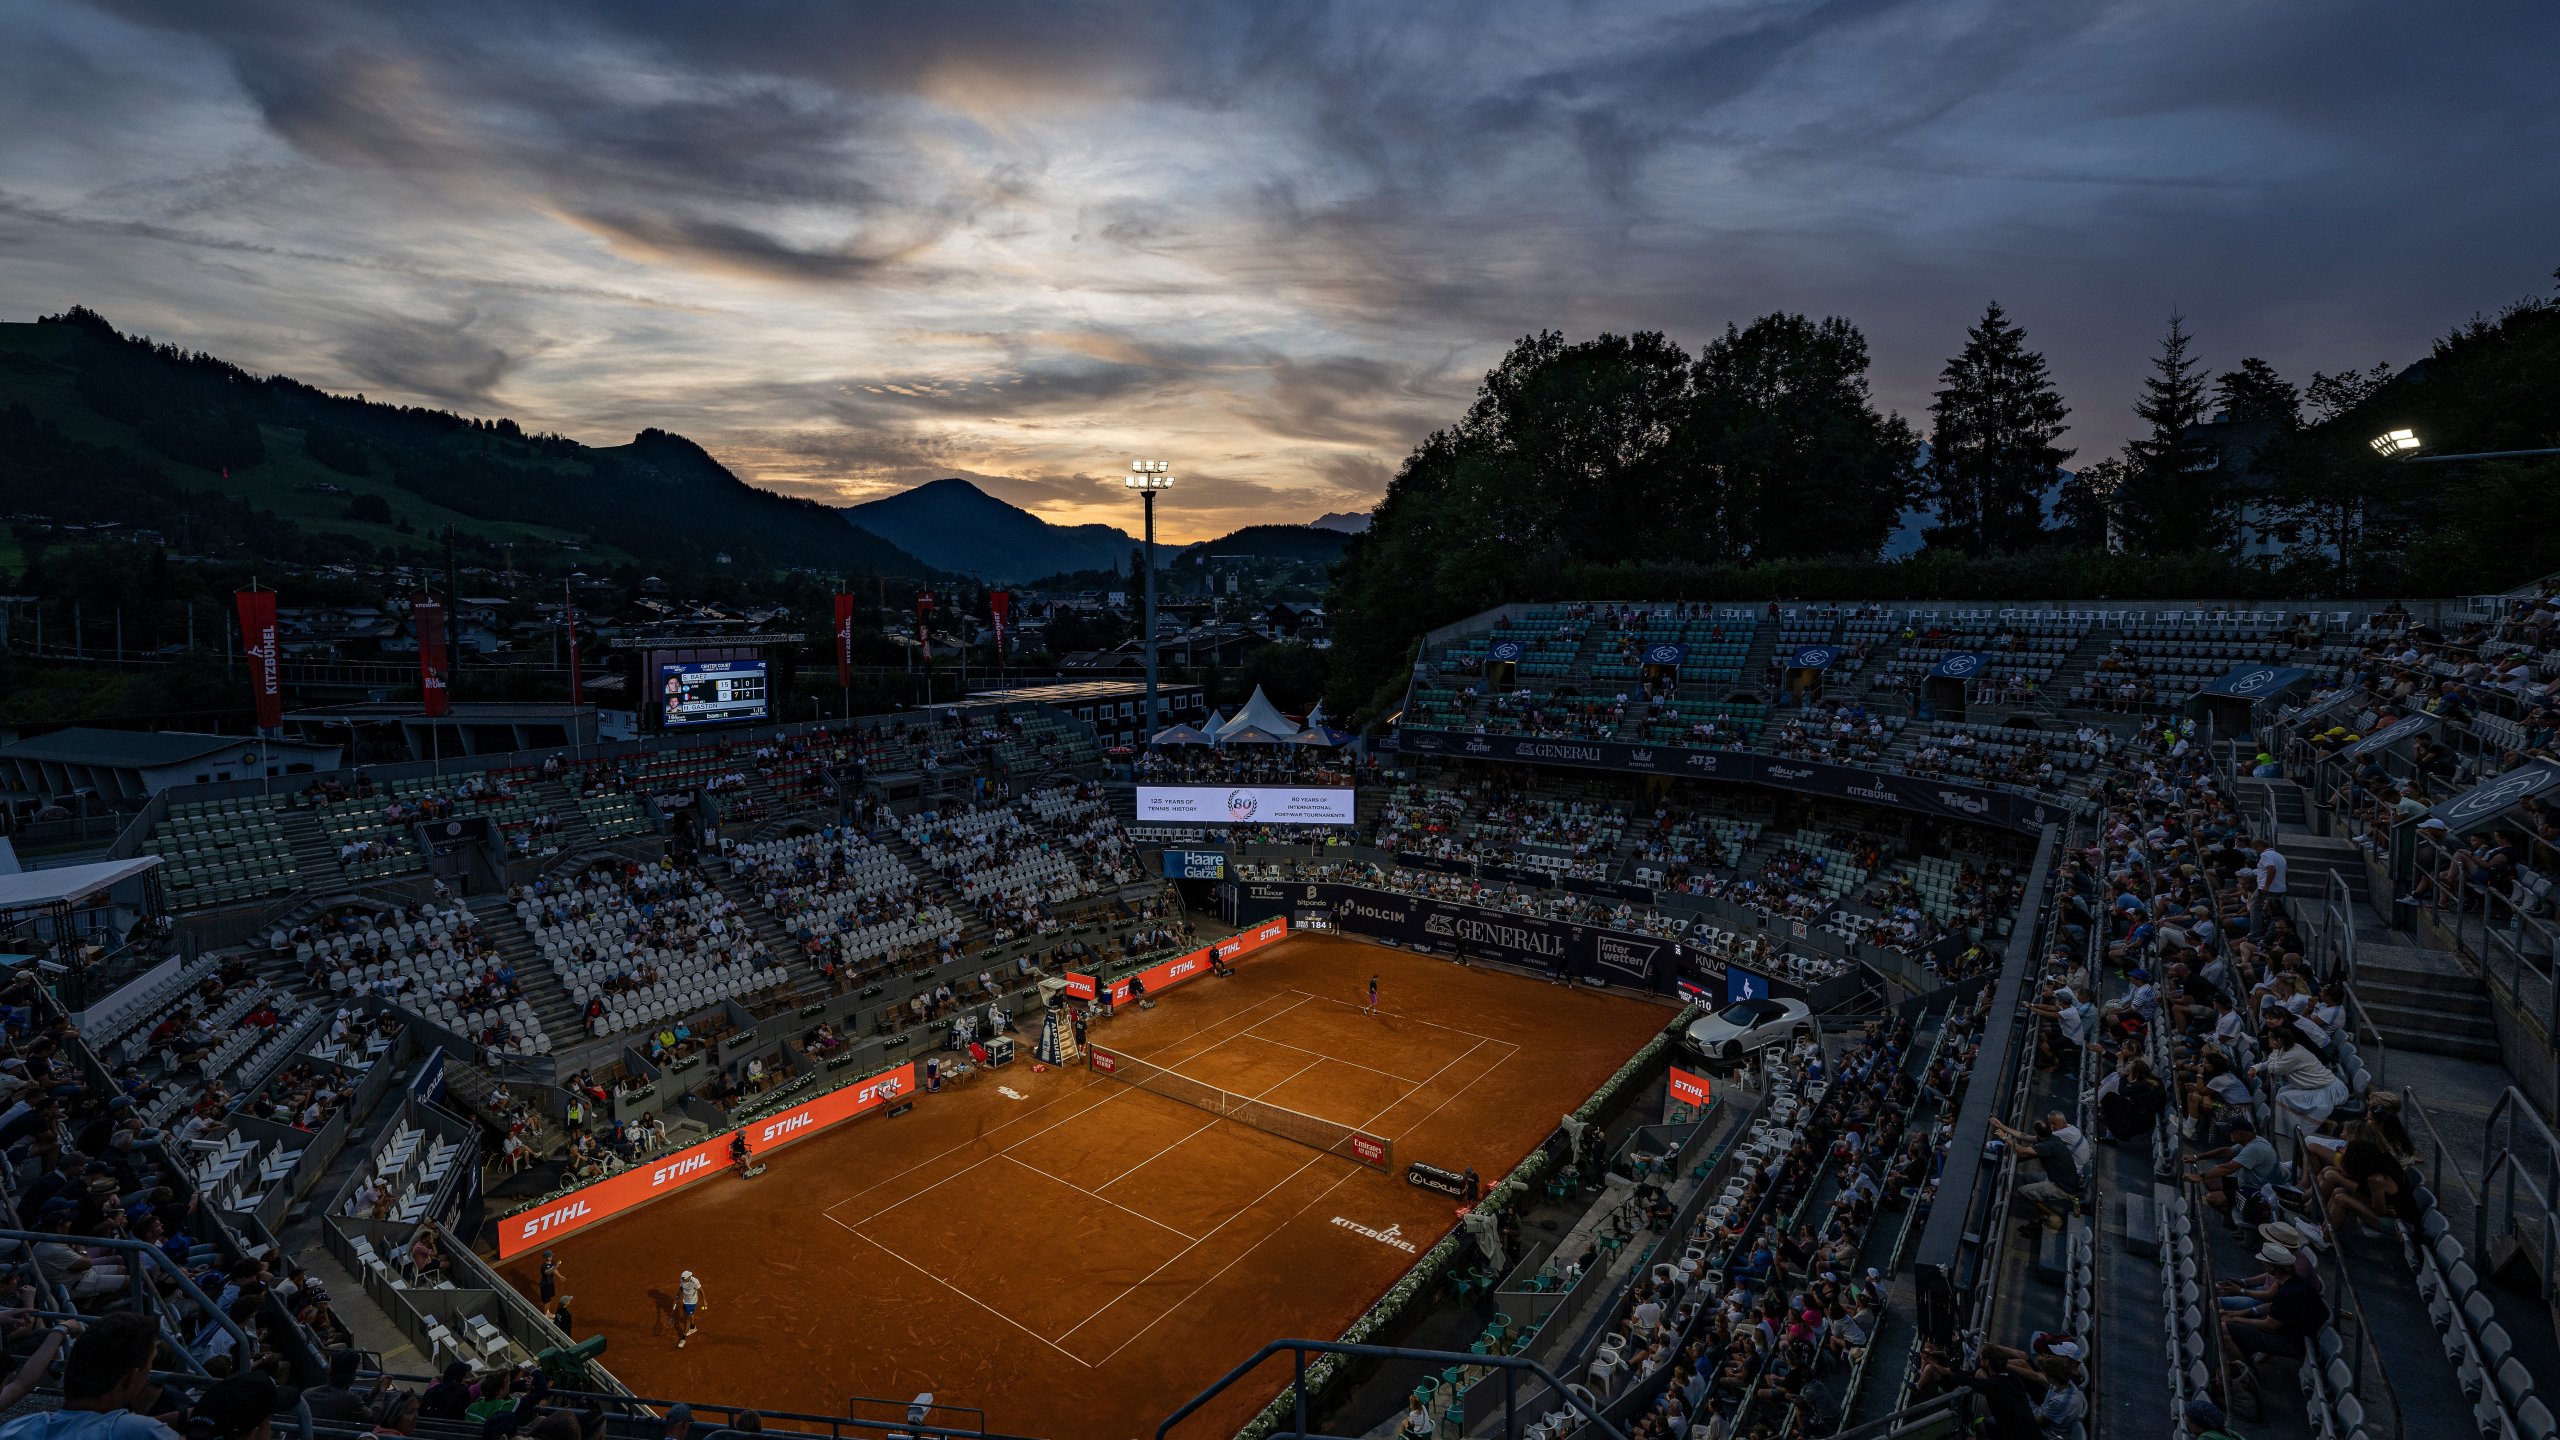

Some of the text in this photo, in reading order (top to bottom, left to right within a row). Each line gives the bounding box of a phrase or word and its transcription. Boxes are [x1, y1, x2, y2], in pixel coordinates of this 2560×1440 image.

[1466, 742, 1491, 753] Zipfer
[1535, 744, 1601, 761] GENERALI
[1686, 754, 1717, 765] ATP
[1234, 798, 1252, 810] 80
[1939, 791, 1989, 814] Tirol
[1185, 852, 1224, 866] Haare
[1184, 866, 1217, 879] Glatze
[1357, 905, 1405, 924] HOLCIM
[1260, 925, 1281, 941] STIHL
[1456, 918, 1563, 956] GENERALI
[1218, 941, 1241, 958] STIHL
[1601, 938, 1630, 955] inter
[1603, 952, 1644, 967] wetten
[1170, 960, 1196, 978] STIHL
[1069, 981, 1092, 993] STIHL
[1693, 997, 1712, 1011] 1:10
[1051, 1022, 1061, 1064] ALPQUELL
[1674, 1079, 1703, 1098] STIHL
[763, 1111, 813, 1142] STIHL
[1354, 1138, 1382, 1155] Emirates
[652, 1152, 711, 1186] STIHL
[1423, 1179, 1461, 1195] LEXUS
[522, 1200, 592, 1239] STIHL
